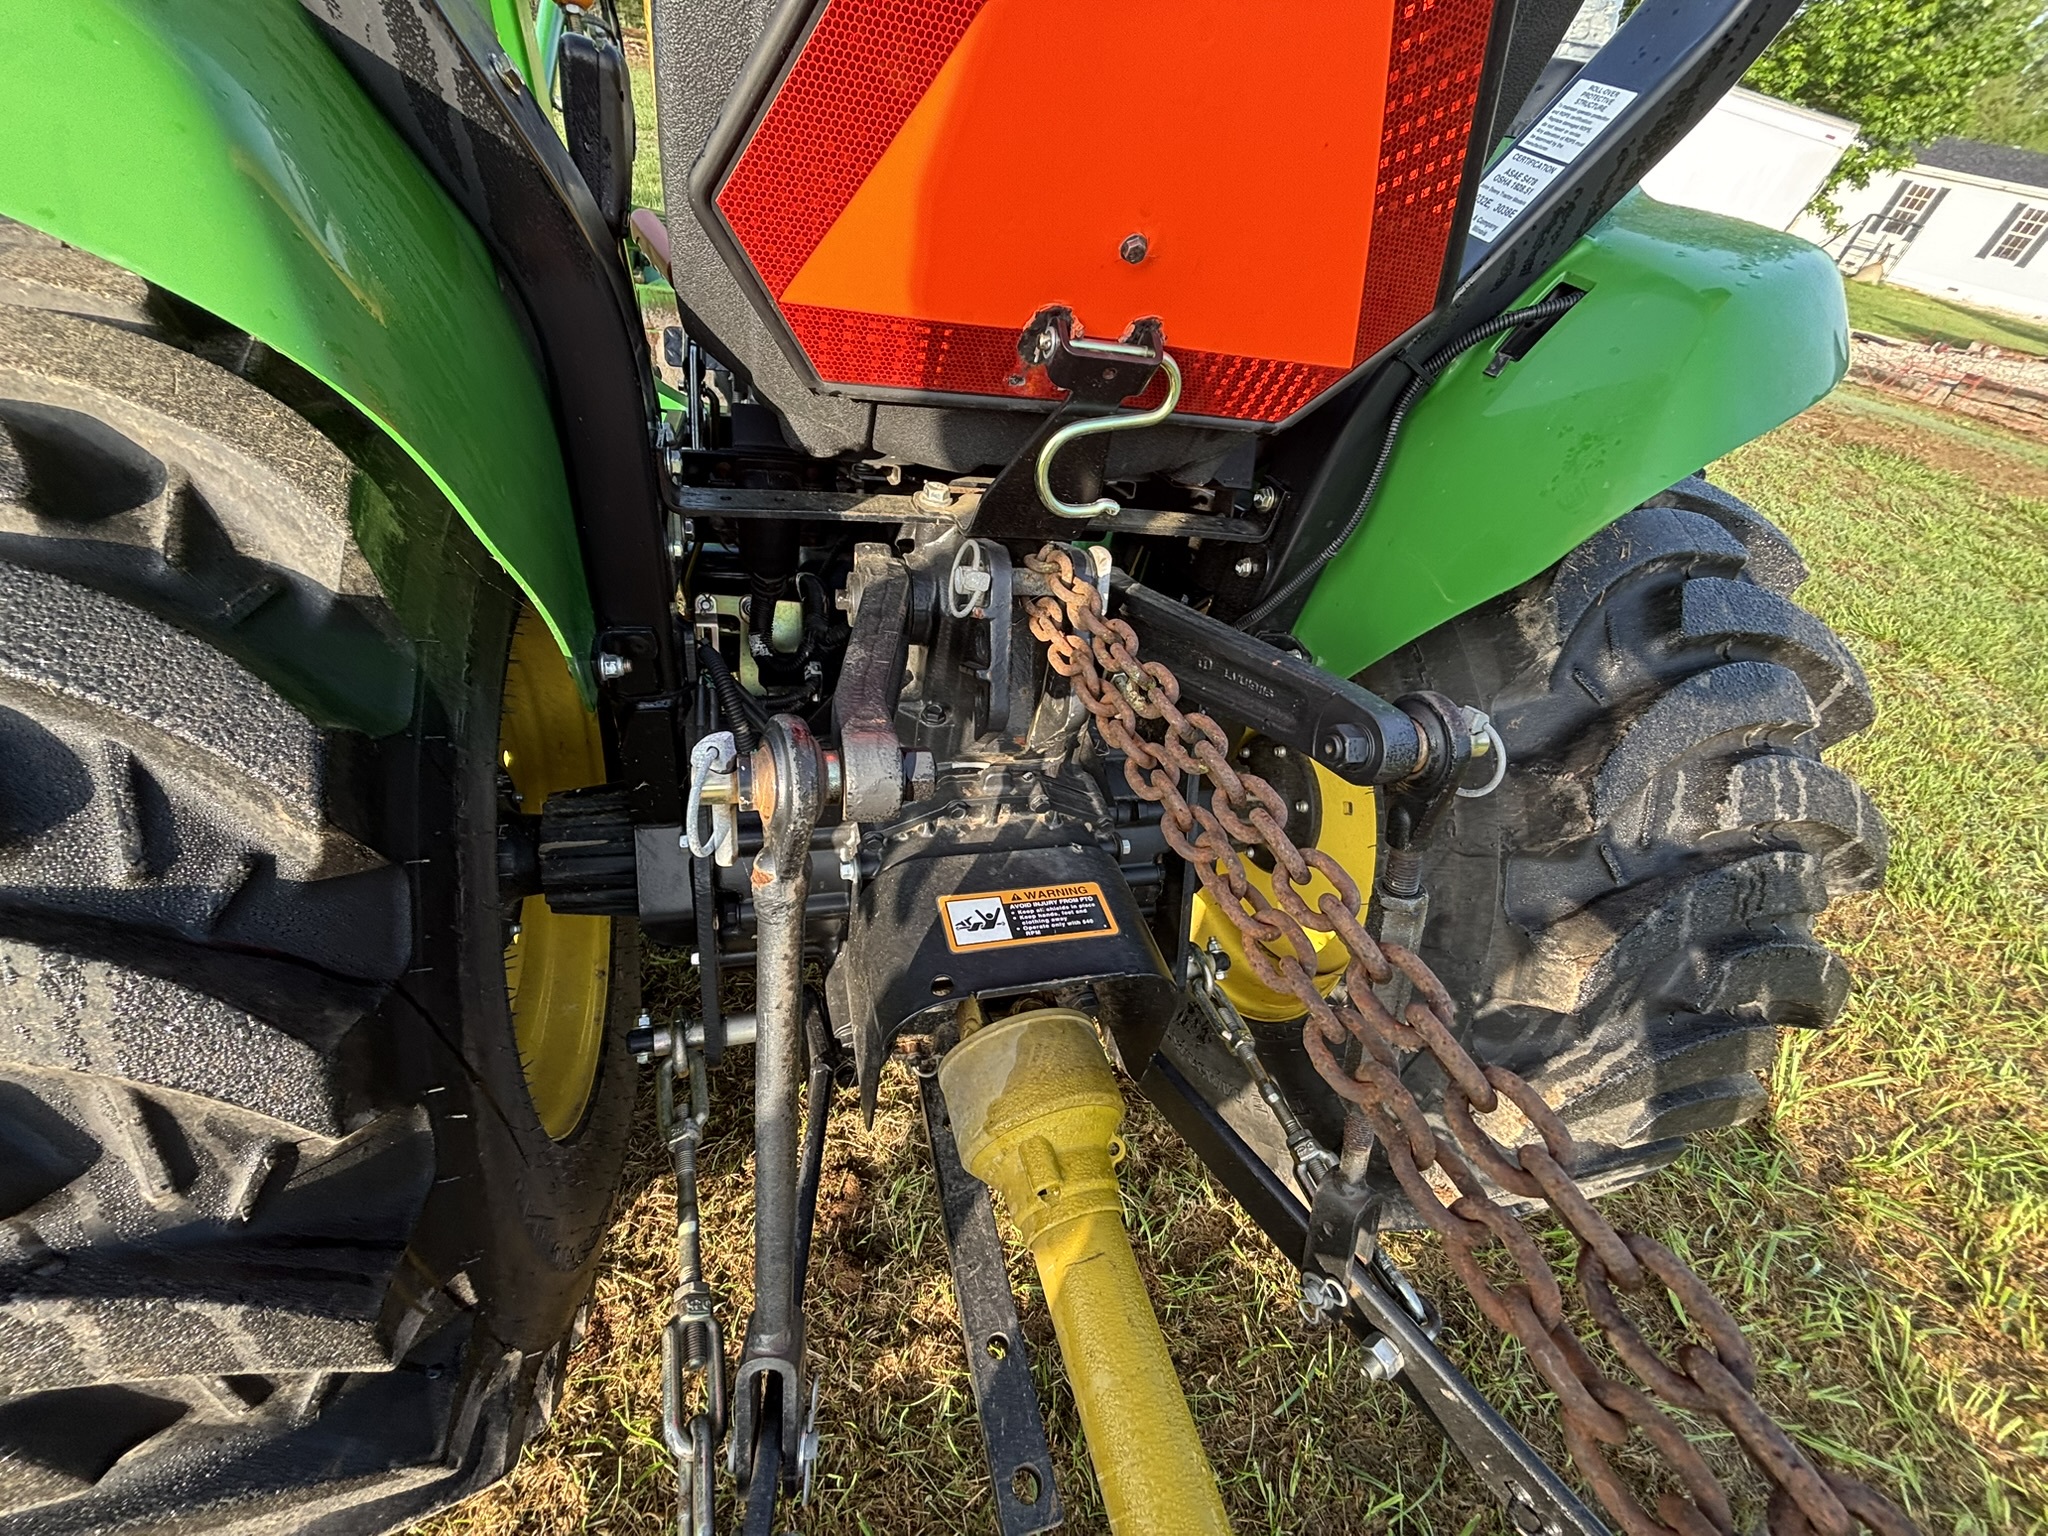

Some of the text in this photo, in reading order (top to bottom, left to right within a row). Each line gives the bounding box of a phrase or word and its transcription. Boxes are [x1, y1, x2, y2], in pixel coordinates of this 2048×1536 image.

[1574, 98, 1608, 112] STRUCTURE
[1580, 91, 1615, 106] PROTECTIVE
[1512, 153, 1557, 174] CERTIFICATION
[1493, 174, 1512, 187] OSHA
[1503, 168, 1523, 181] ASAE
[1493, 203, 1518, 219] 3038E
[1477, 216, 1499, 231] Company
[1024, 886, 1088, 900] WARNING
[1032, 900, 1059, 908] INJURY
[1021, 918, 1050, 926] clothing
[1022, 923, 1050, 932] Operate
